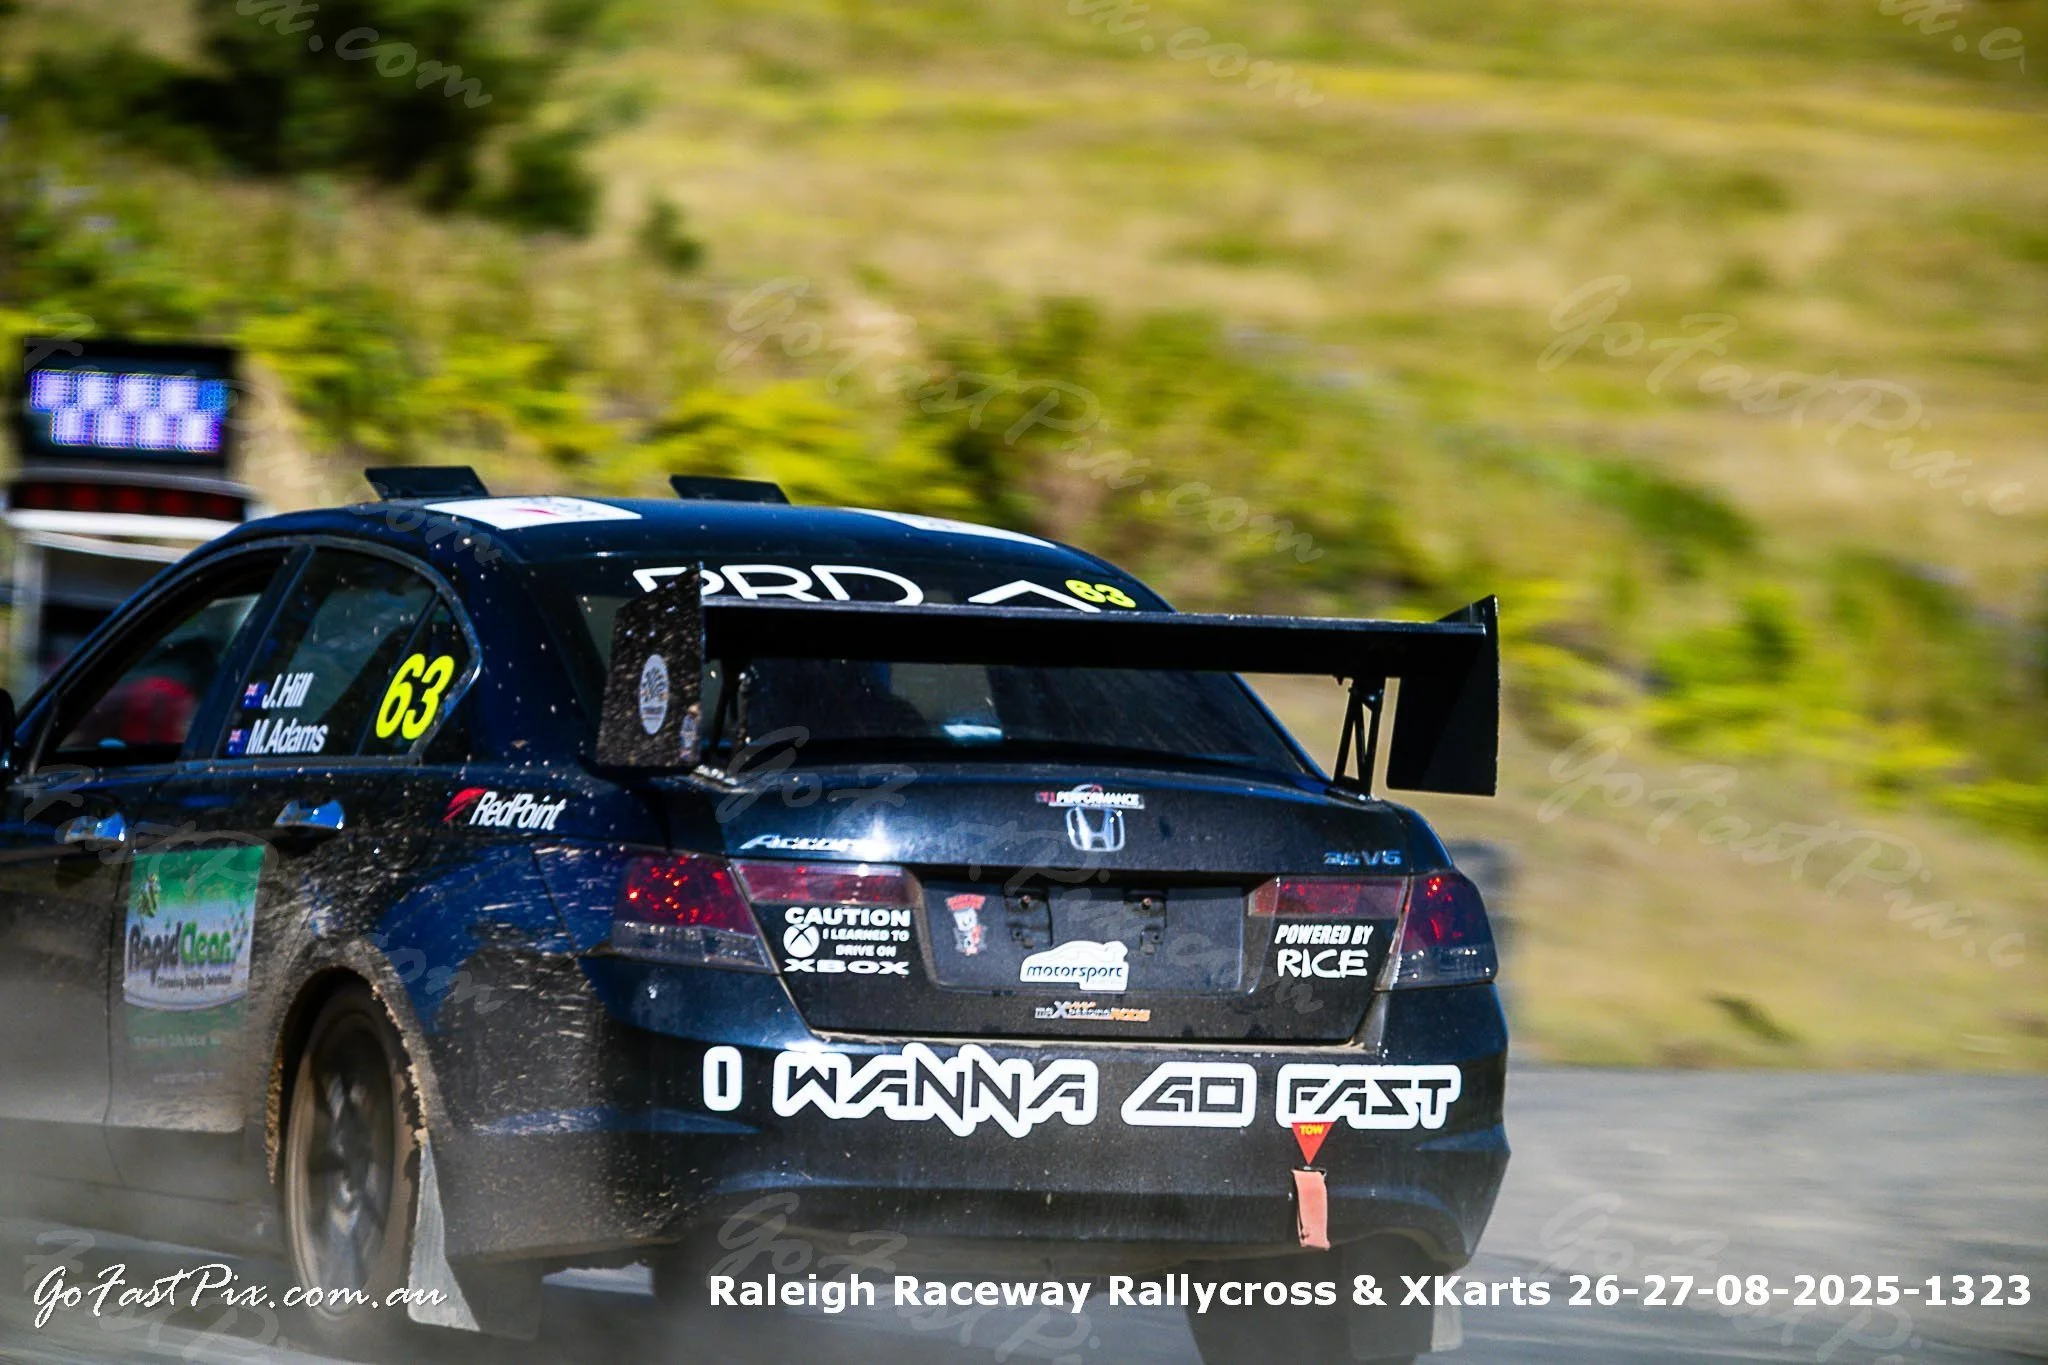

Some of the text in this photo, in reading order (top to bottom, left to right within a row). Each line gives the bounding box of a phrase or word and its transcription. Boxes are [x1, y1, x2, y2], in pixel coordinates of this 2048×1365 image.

[1064, 579, 1137, 608] 63
[375, 652, 455, 740] 63
[246, 718, 329, 755] M.Adams
[469, 791, 567, 831] RedPoint
[784, 906, 911, 927] CAUTION
[830, 928, 889, 942] LEARNED
[890, 929, 910, 942] TO
[1274, 924, 1374, 945] POWERED BY
[835, 944, 897, 957] DRIVE ON
[783, 958, 909, 975] XBOX
[1277, 948, 1369, 979] RICE
[1026, 966, 1122, 983] motorsport
[772, 1042, 1099, 1138] WANNA
[1121, 1061, 1257, 1127] GO
[1275, 1063, 1462, 1129] FAST
[1300, 1124, 1324, 1135] TOW
